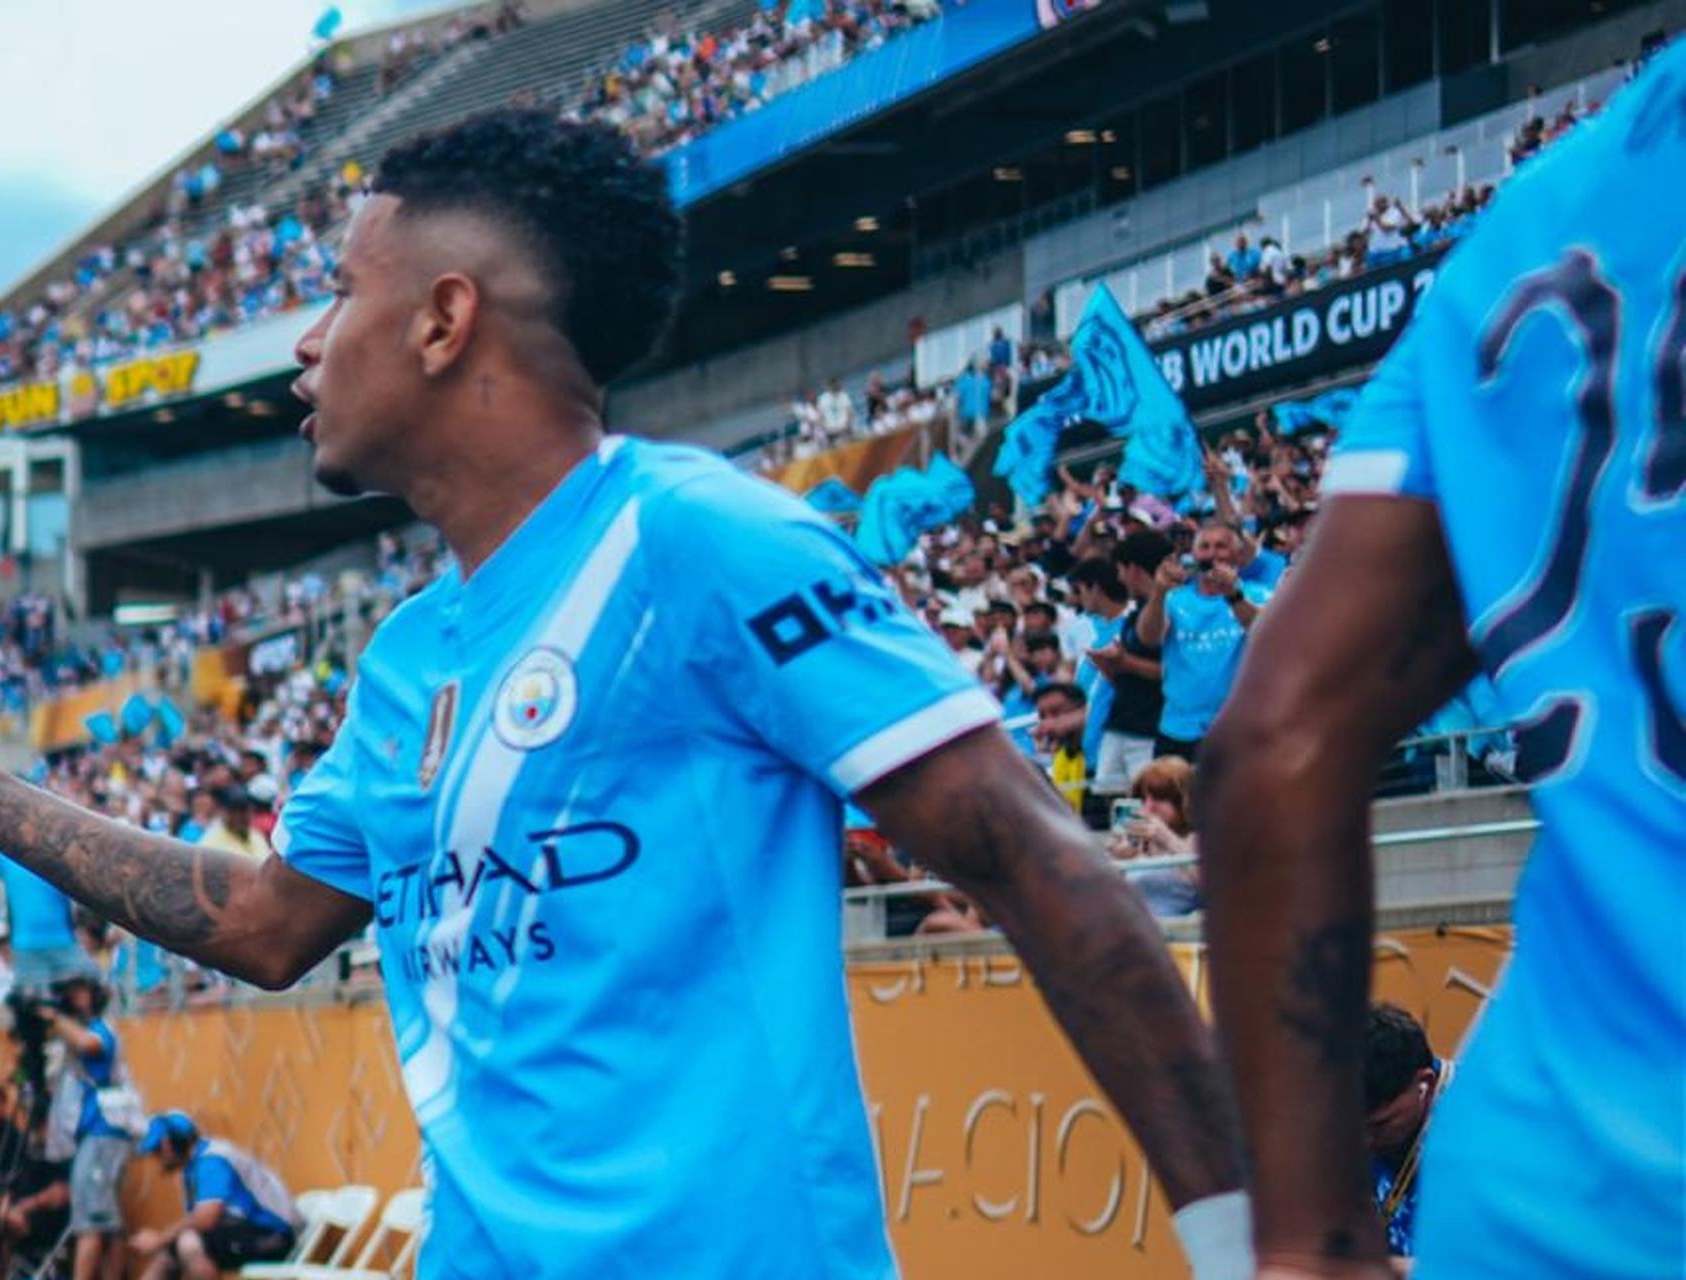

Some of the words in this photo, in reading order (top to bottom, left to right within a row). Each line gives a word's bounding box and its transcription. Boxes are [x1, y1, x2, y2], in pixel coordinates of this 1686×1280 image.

[1189, 307, 1320, 388] WORLD
[1327, 279, 1406, 346] CUP
[377, 820, 641, 929] ETIHAD
